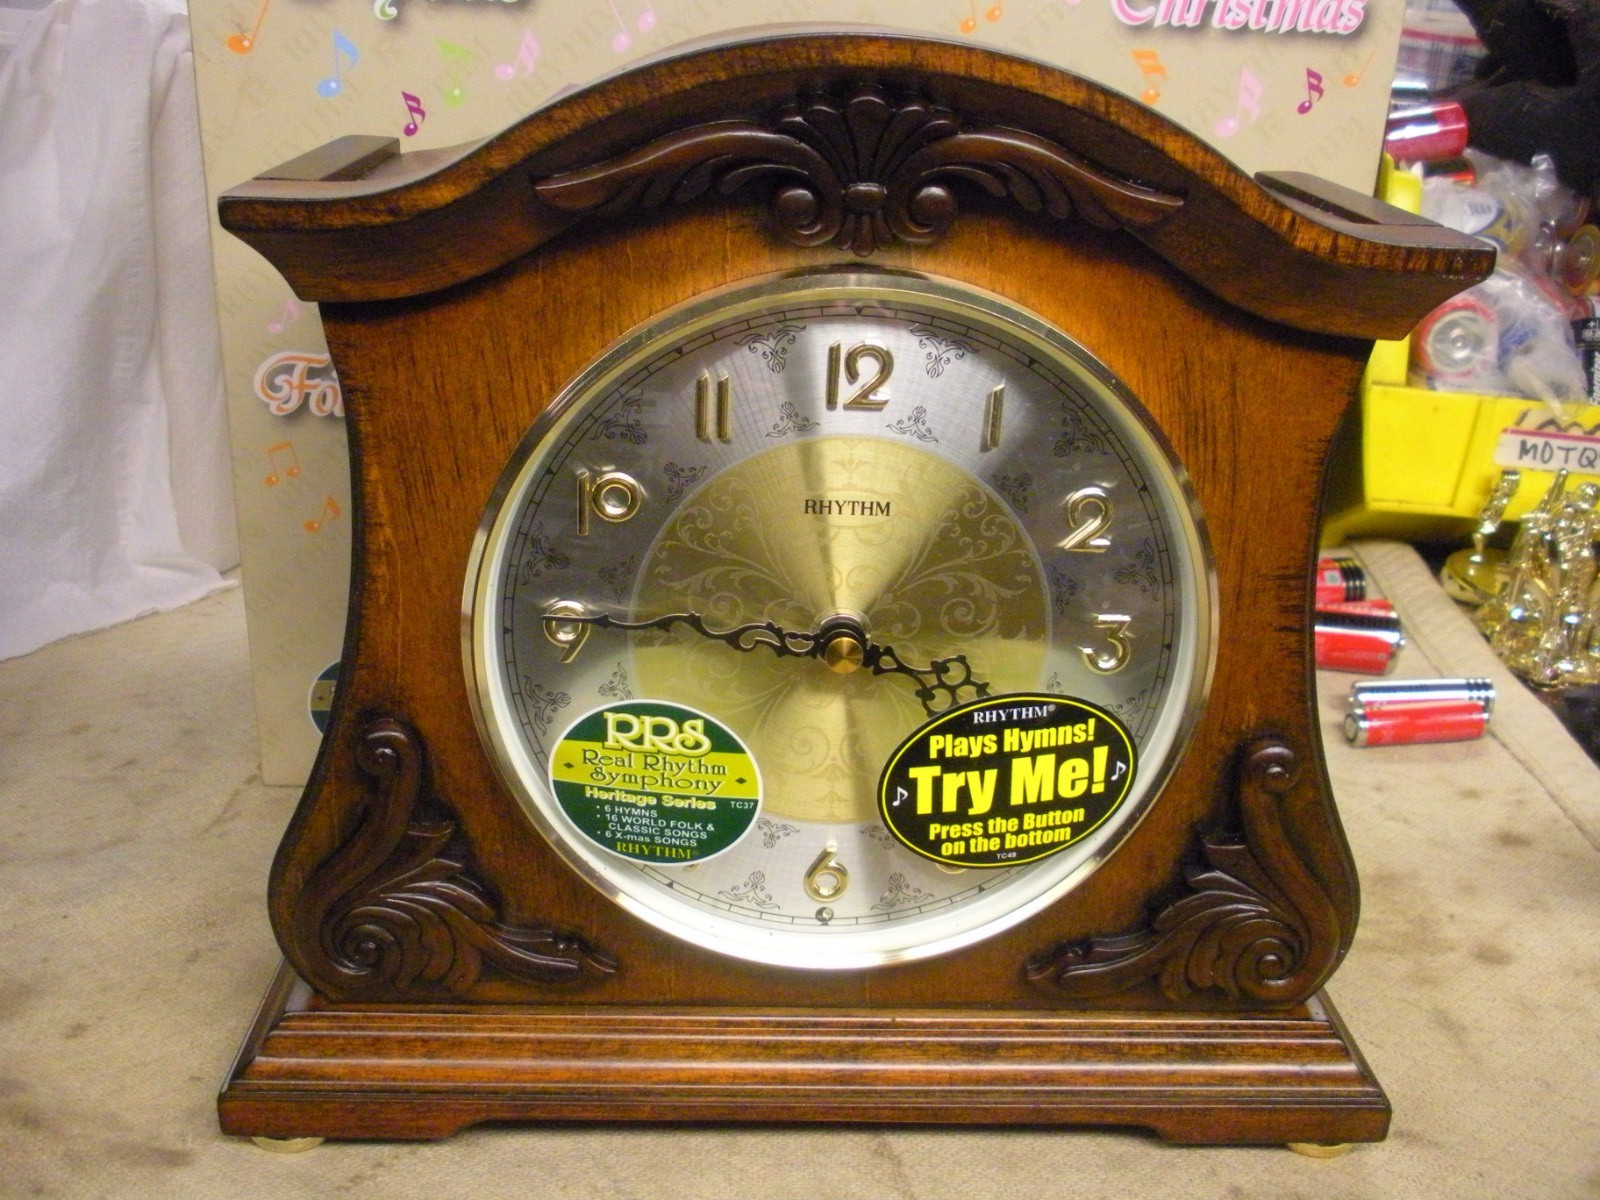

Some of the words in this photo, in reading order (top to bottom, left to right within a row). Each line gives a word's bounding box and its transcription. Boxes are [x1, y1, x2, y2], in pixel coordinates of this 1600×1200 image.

[826, 340, 894, 411] 12
[696, 371, 730, 442] 11
[985, 383, 1005, 450] 1
[577, 471, 642, 536] 10
[803, 498, 892, 518] RHYTHM
[1062, 486, 1113, 553] 2
[543, 600, 591, 664] 9
[1082, 613, 1132, 676] 3
[602, 711, 713, 757] RRS
[929, 733, 998, 759] Plays
[1003, 718, 1096, 752] Hymns!
[582, 749, 633, 768] Real
[643, 754, 727, 777] Rhythm
[590, 766, 725, 795] Symphony
[908, 766, 998, 815] Try
[1010, 745, 1109, 806] Me!
[585, 785, 657, 806] Heritage
[662, 795, 717, 811] Series
[604, 804, 612, 813] 6
[614, 806, 658, 818] HYMNS
[730, 801, 754, 810] TC37
[605, 814, 618, 822] 16
[621, 815, 667, 828] WORLD
[670, 820, 703, 831] FOLK
[706, 823, 715, 832] &
[608, 822, 661, 835] CLASSIC
[664, 829, 708, 840] SONGS
[929, 819, 984, 841] Press
[988, 816, 1019, 835] the
[1023, 808, 1085, 830] Button
[615, 831, 651, 843] X-mas
[654, 836, 698, 847] SONGS
[616, 841, 692, 859] RHYTHM
[941, 839, 966, 856] on
[969, 835, 1001, 853] the
[1004, 826, 1071, 849] bottom
[996, 851, 1017, 860] TC49
[803, 844, 849, 902] 6
